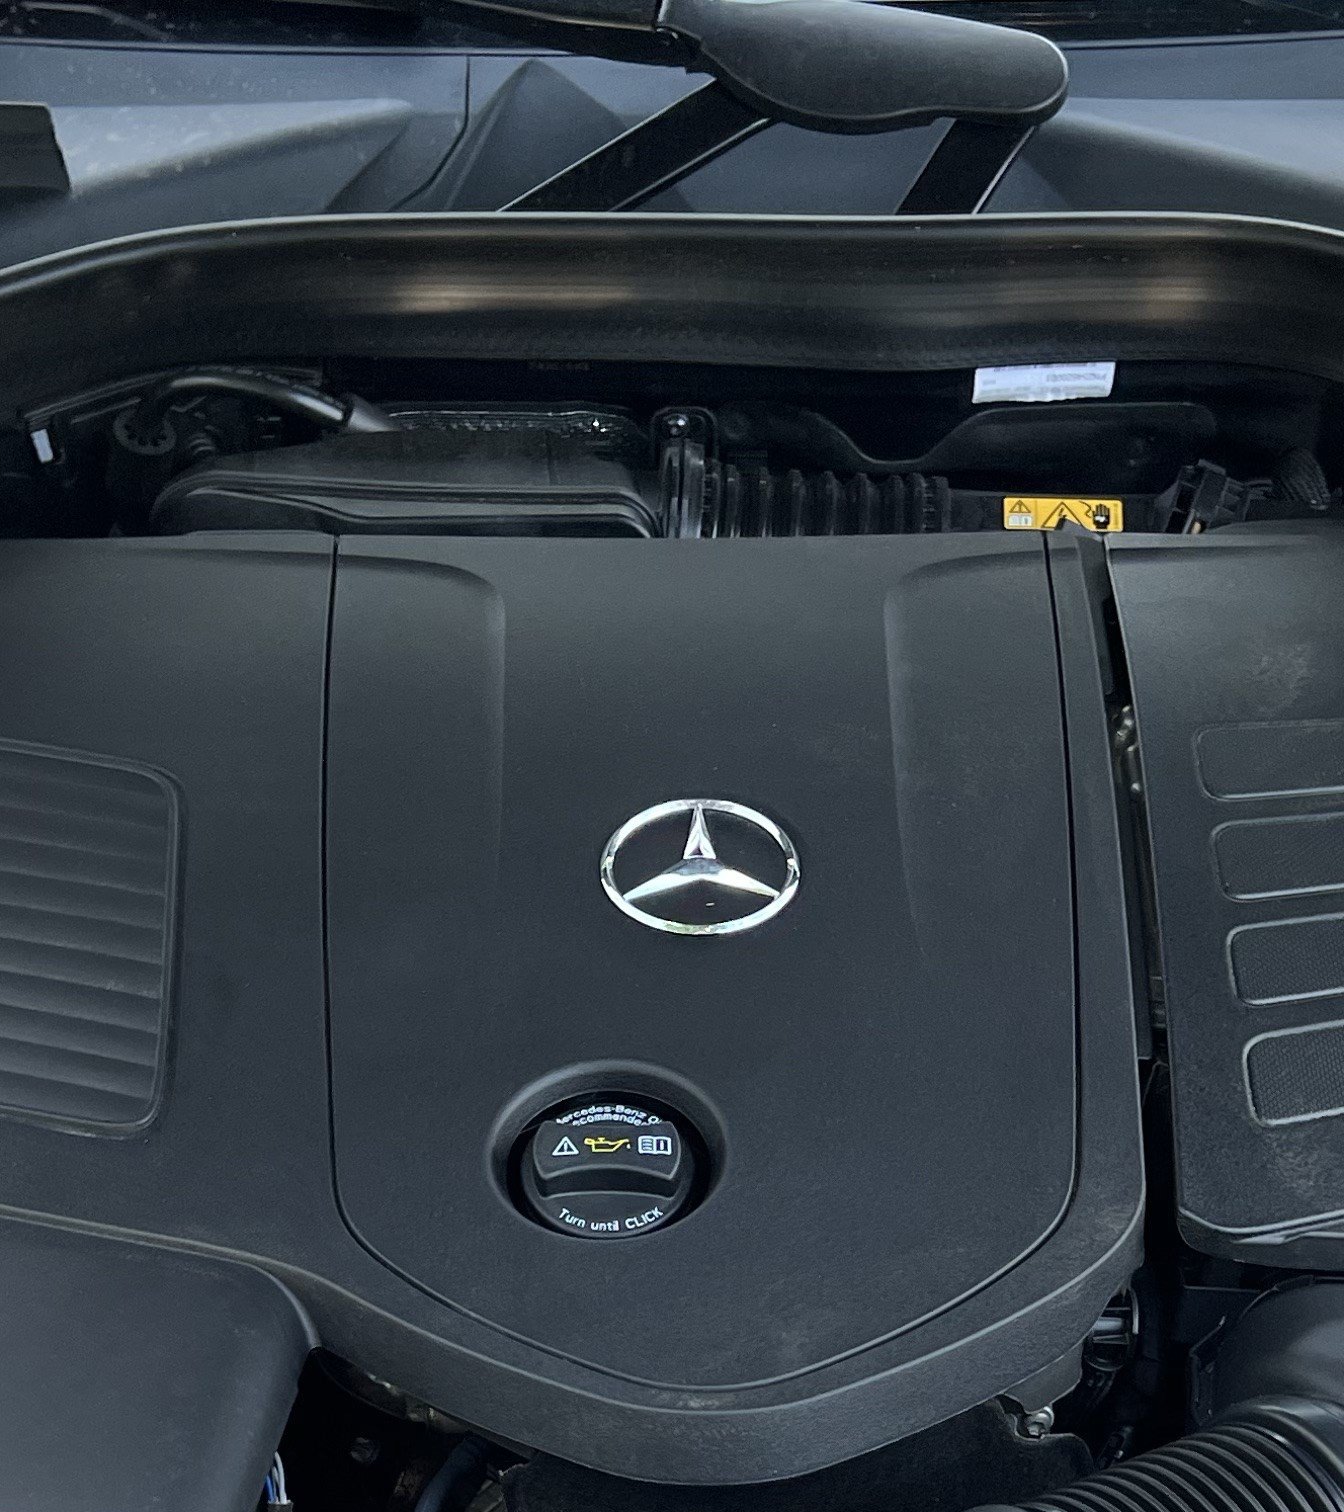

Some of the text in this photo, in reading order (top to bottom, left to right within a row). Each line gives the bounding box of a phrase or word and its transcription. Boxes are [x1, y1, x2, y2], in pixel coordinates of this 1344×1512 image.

[558, 1206, 664, 1232] Turn until CLICK
